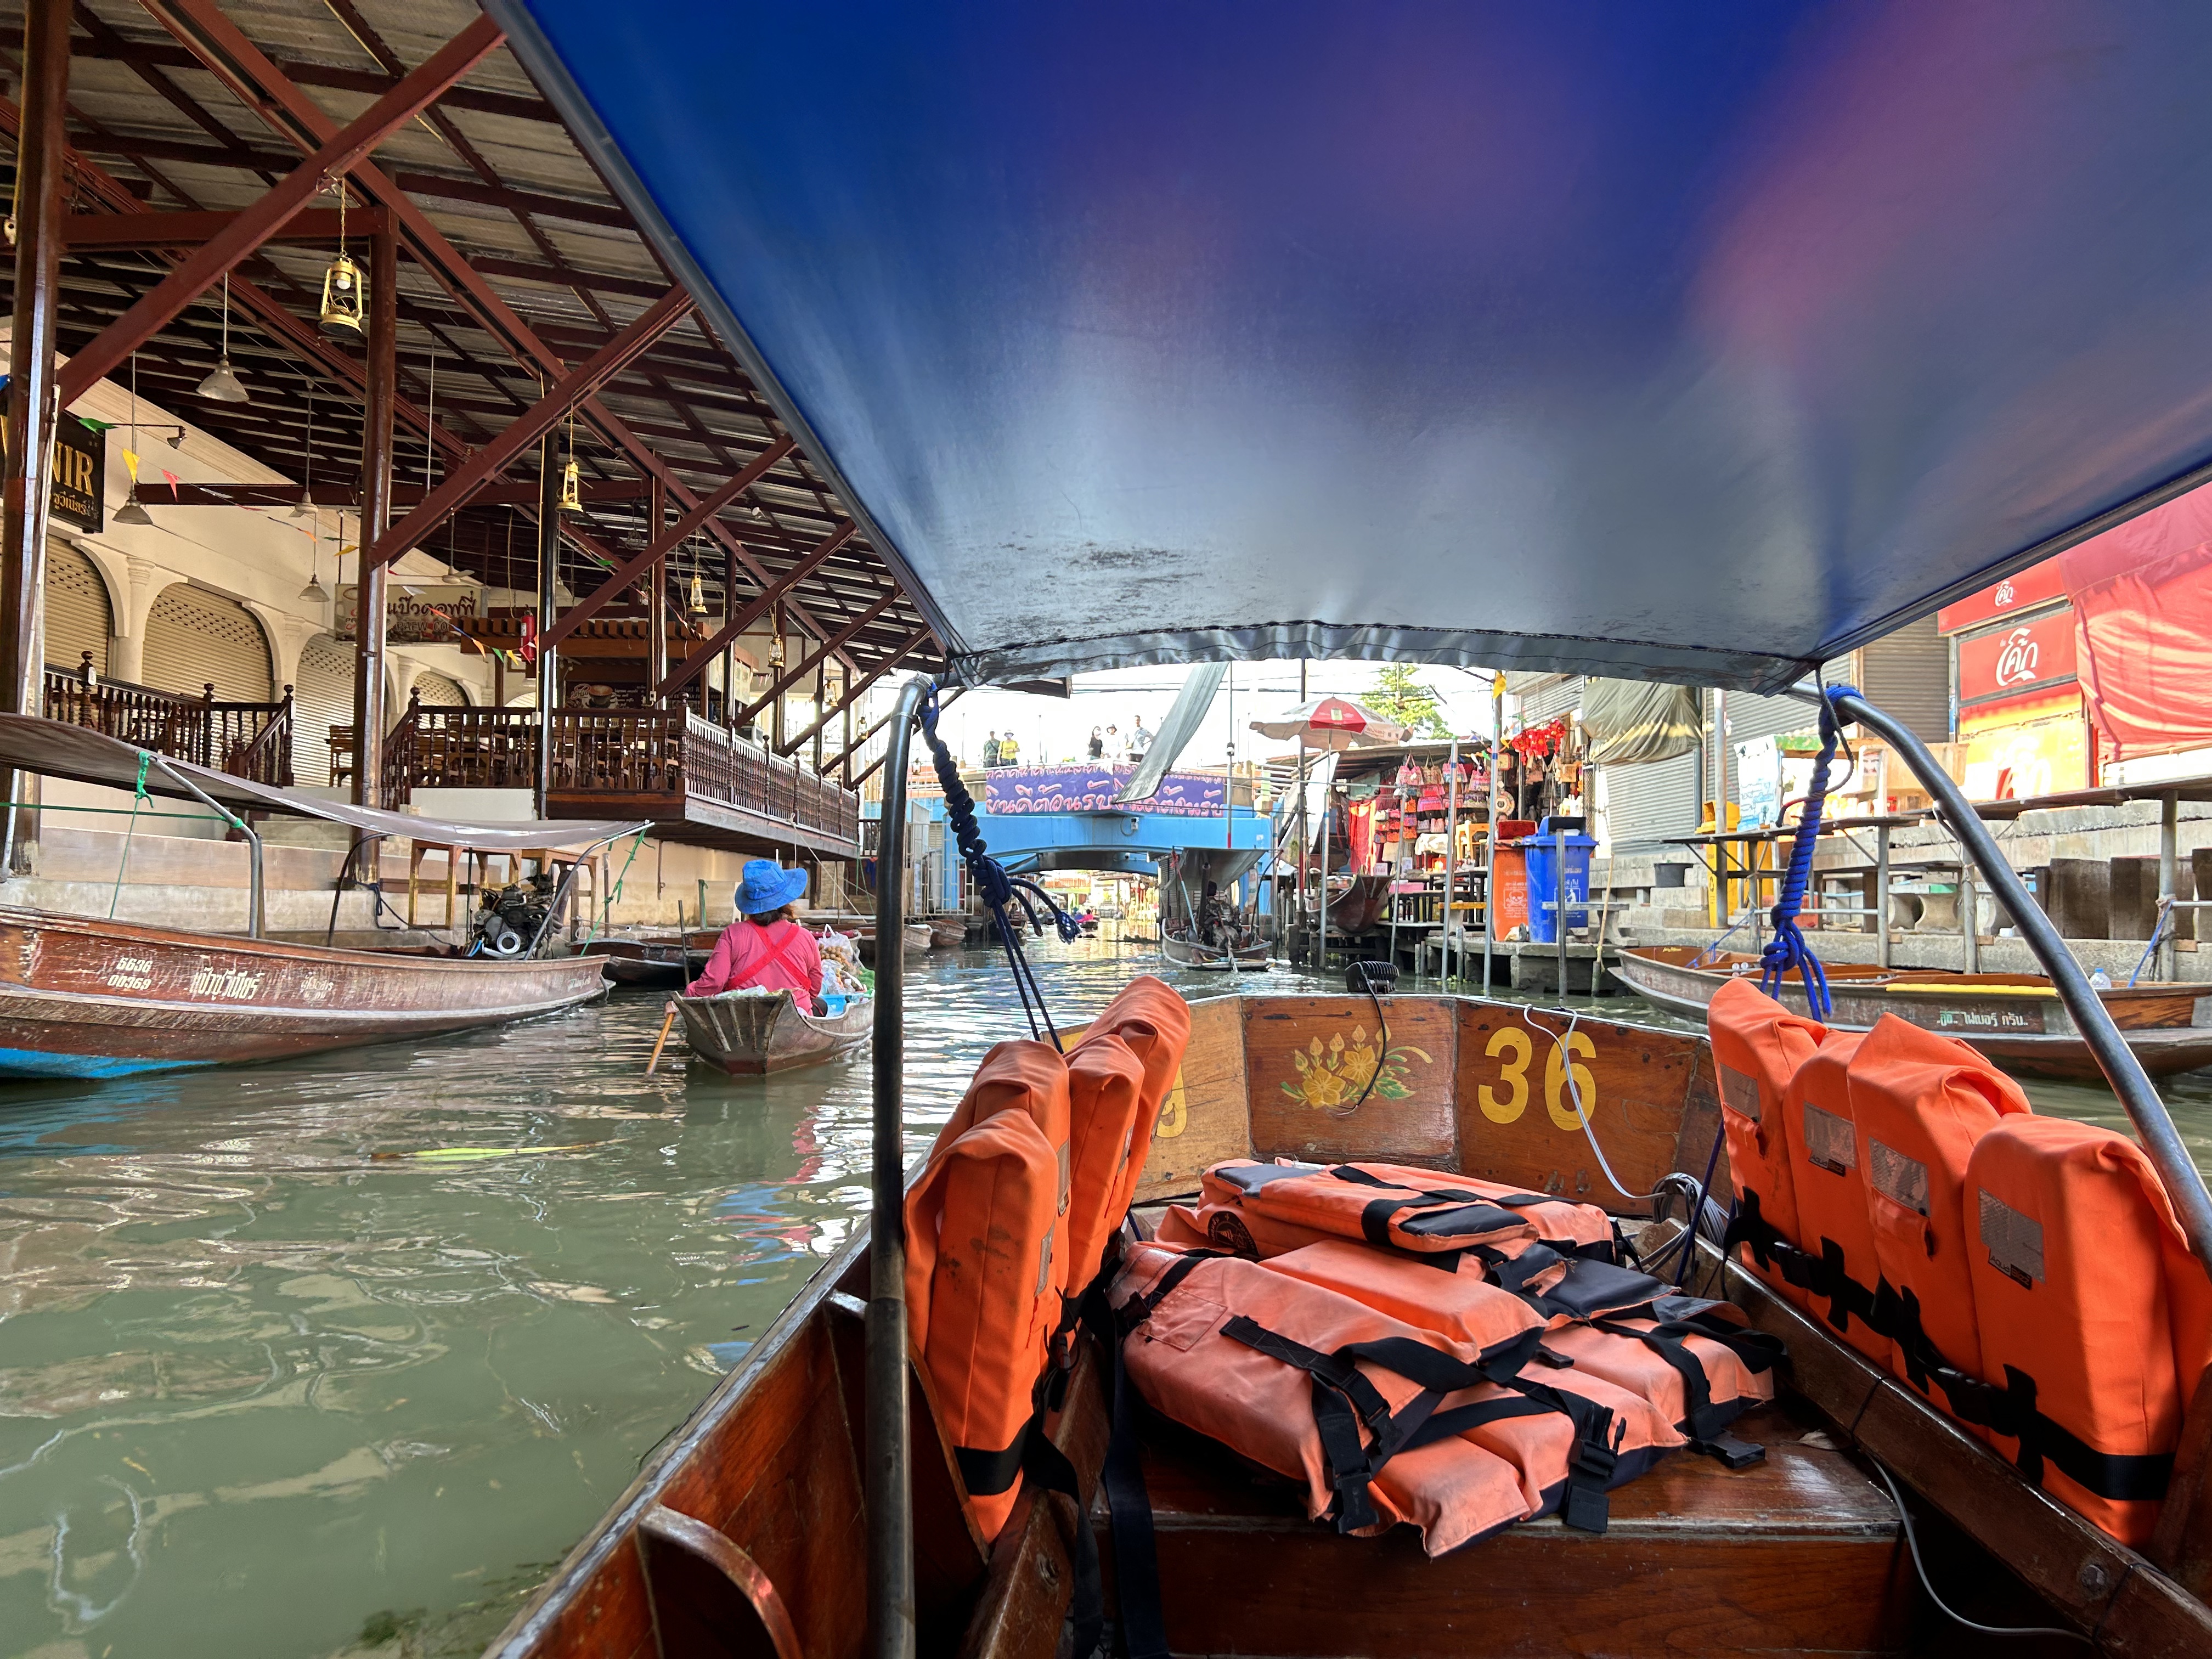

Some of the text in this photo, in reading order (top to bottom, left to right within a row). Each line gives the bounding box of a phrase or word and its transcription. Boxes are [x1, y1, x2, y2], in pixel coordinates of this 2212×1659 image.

[433, 620, 449, 631] CO
[985, 780, 1113, 814] ยินดีต้อนรับ
[116, 957, 153, 973] 5636
[107, 974, 152, 990] 00369
[1478, 1026, 1597, 1131] 36
